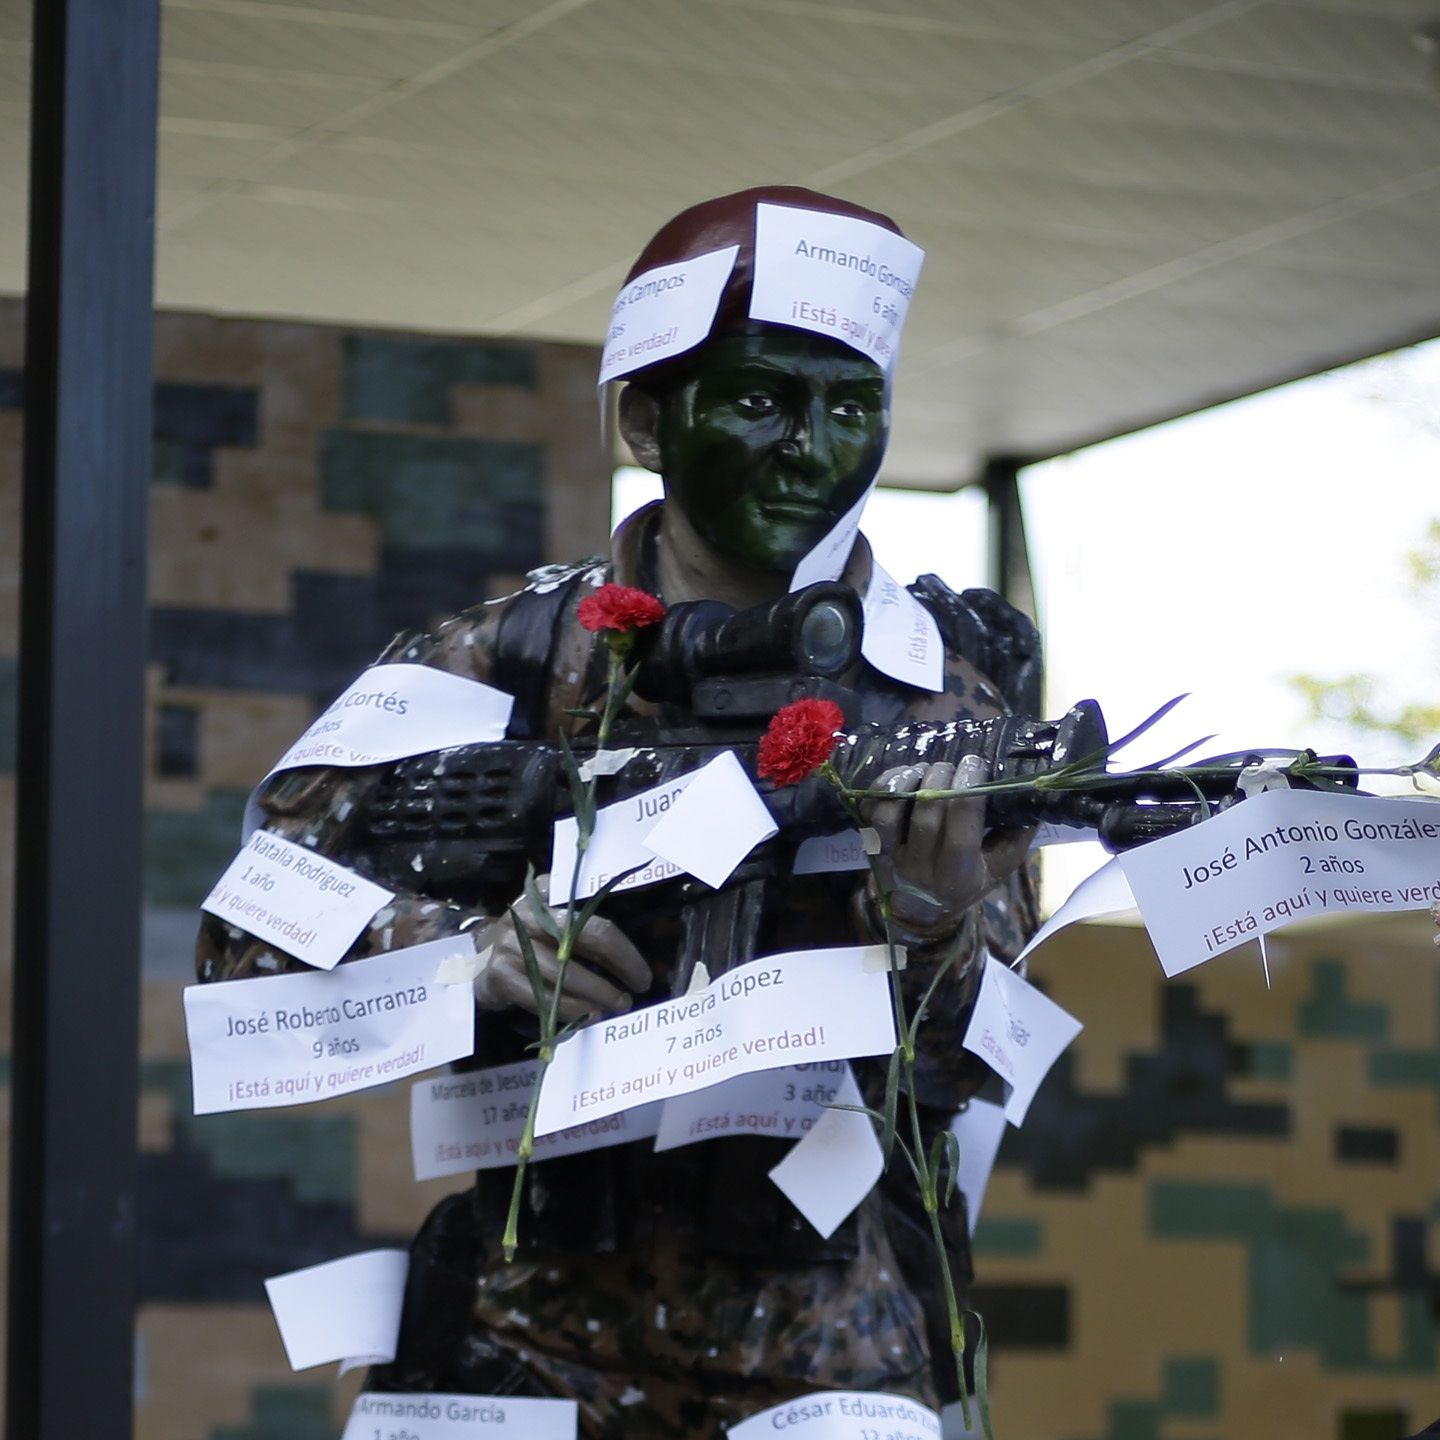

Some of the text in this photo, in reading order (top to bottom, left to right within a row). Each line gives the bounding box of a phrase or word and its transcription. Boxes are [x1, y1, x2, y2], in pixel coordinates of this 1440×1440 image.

[794, 239, 876, 277] Armando
[629, 273, 686, 304] Campos
[791, 300, 837, 328] ¡Está
[873, 296, 882, 314] 6
[628, 326, 679, 358] verdad!
[344, 688, 409, 715] Cortés
[249, 835, 357, 898] Natalia Rodríguez
[1182, 847, 1239, 889] José
[1245, 820, 1339, 860] Antonio
[1298, 855, 1365, 875] 2 años
[240, 866, 276, 893] 1 año
[642, 862, 682, 883] aqu
[218, 892, 319, 948] y quiere verdad!
[1203, 911, 1258, 953] ¡Está
[1263, 887, 1312, 924] aquí
[1315, 890, 1329, 909] y
[1334, 884, 1393, 906] quiere
[225, 985, 428, 1037] José Roberto Carranza
[604, 967, 785, 1044] Raúl Rivera López
[312, 1036, 361, 1060] 9 años
[665, 1023, 724, 1055] 7 años
[228, 1045, 426, 1102] ¡Está aquí y quiere verdad!
[572, 1081, 617, 1113] ¡Está
[620, 1065, 662, 1097] aquí
[667, 1068, 679, 1084] y
[682, 1046, 739, 1079] quiere
[741, 1026, 827, 1056] verdad!
[479, 1078, 495, 1095] de
[784, 1084, 796, 1102] 3
[482, 1105, 498, 1126] 17
[689, 1113, 730, 1137] ¡Está
[735, 1112, 780, 1132] aquí
[783, 1115, 795, 1133] y
[360, 1399, 507, 1424] Armando García
[771, 1400, 833, 1430] César
[839, 1398, 918, 1423] Eduardo
